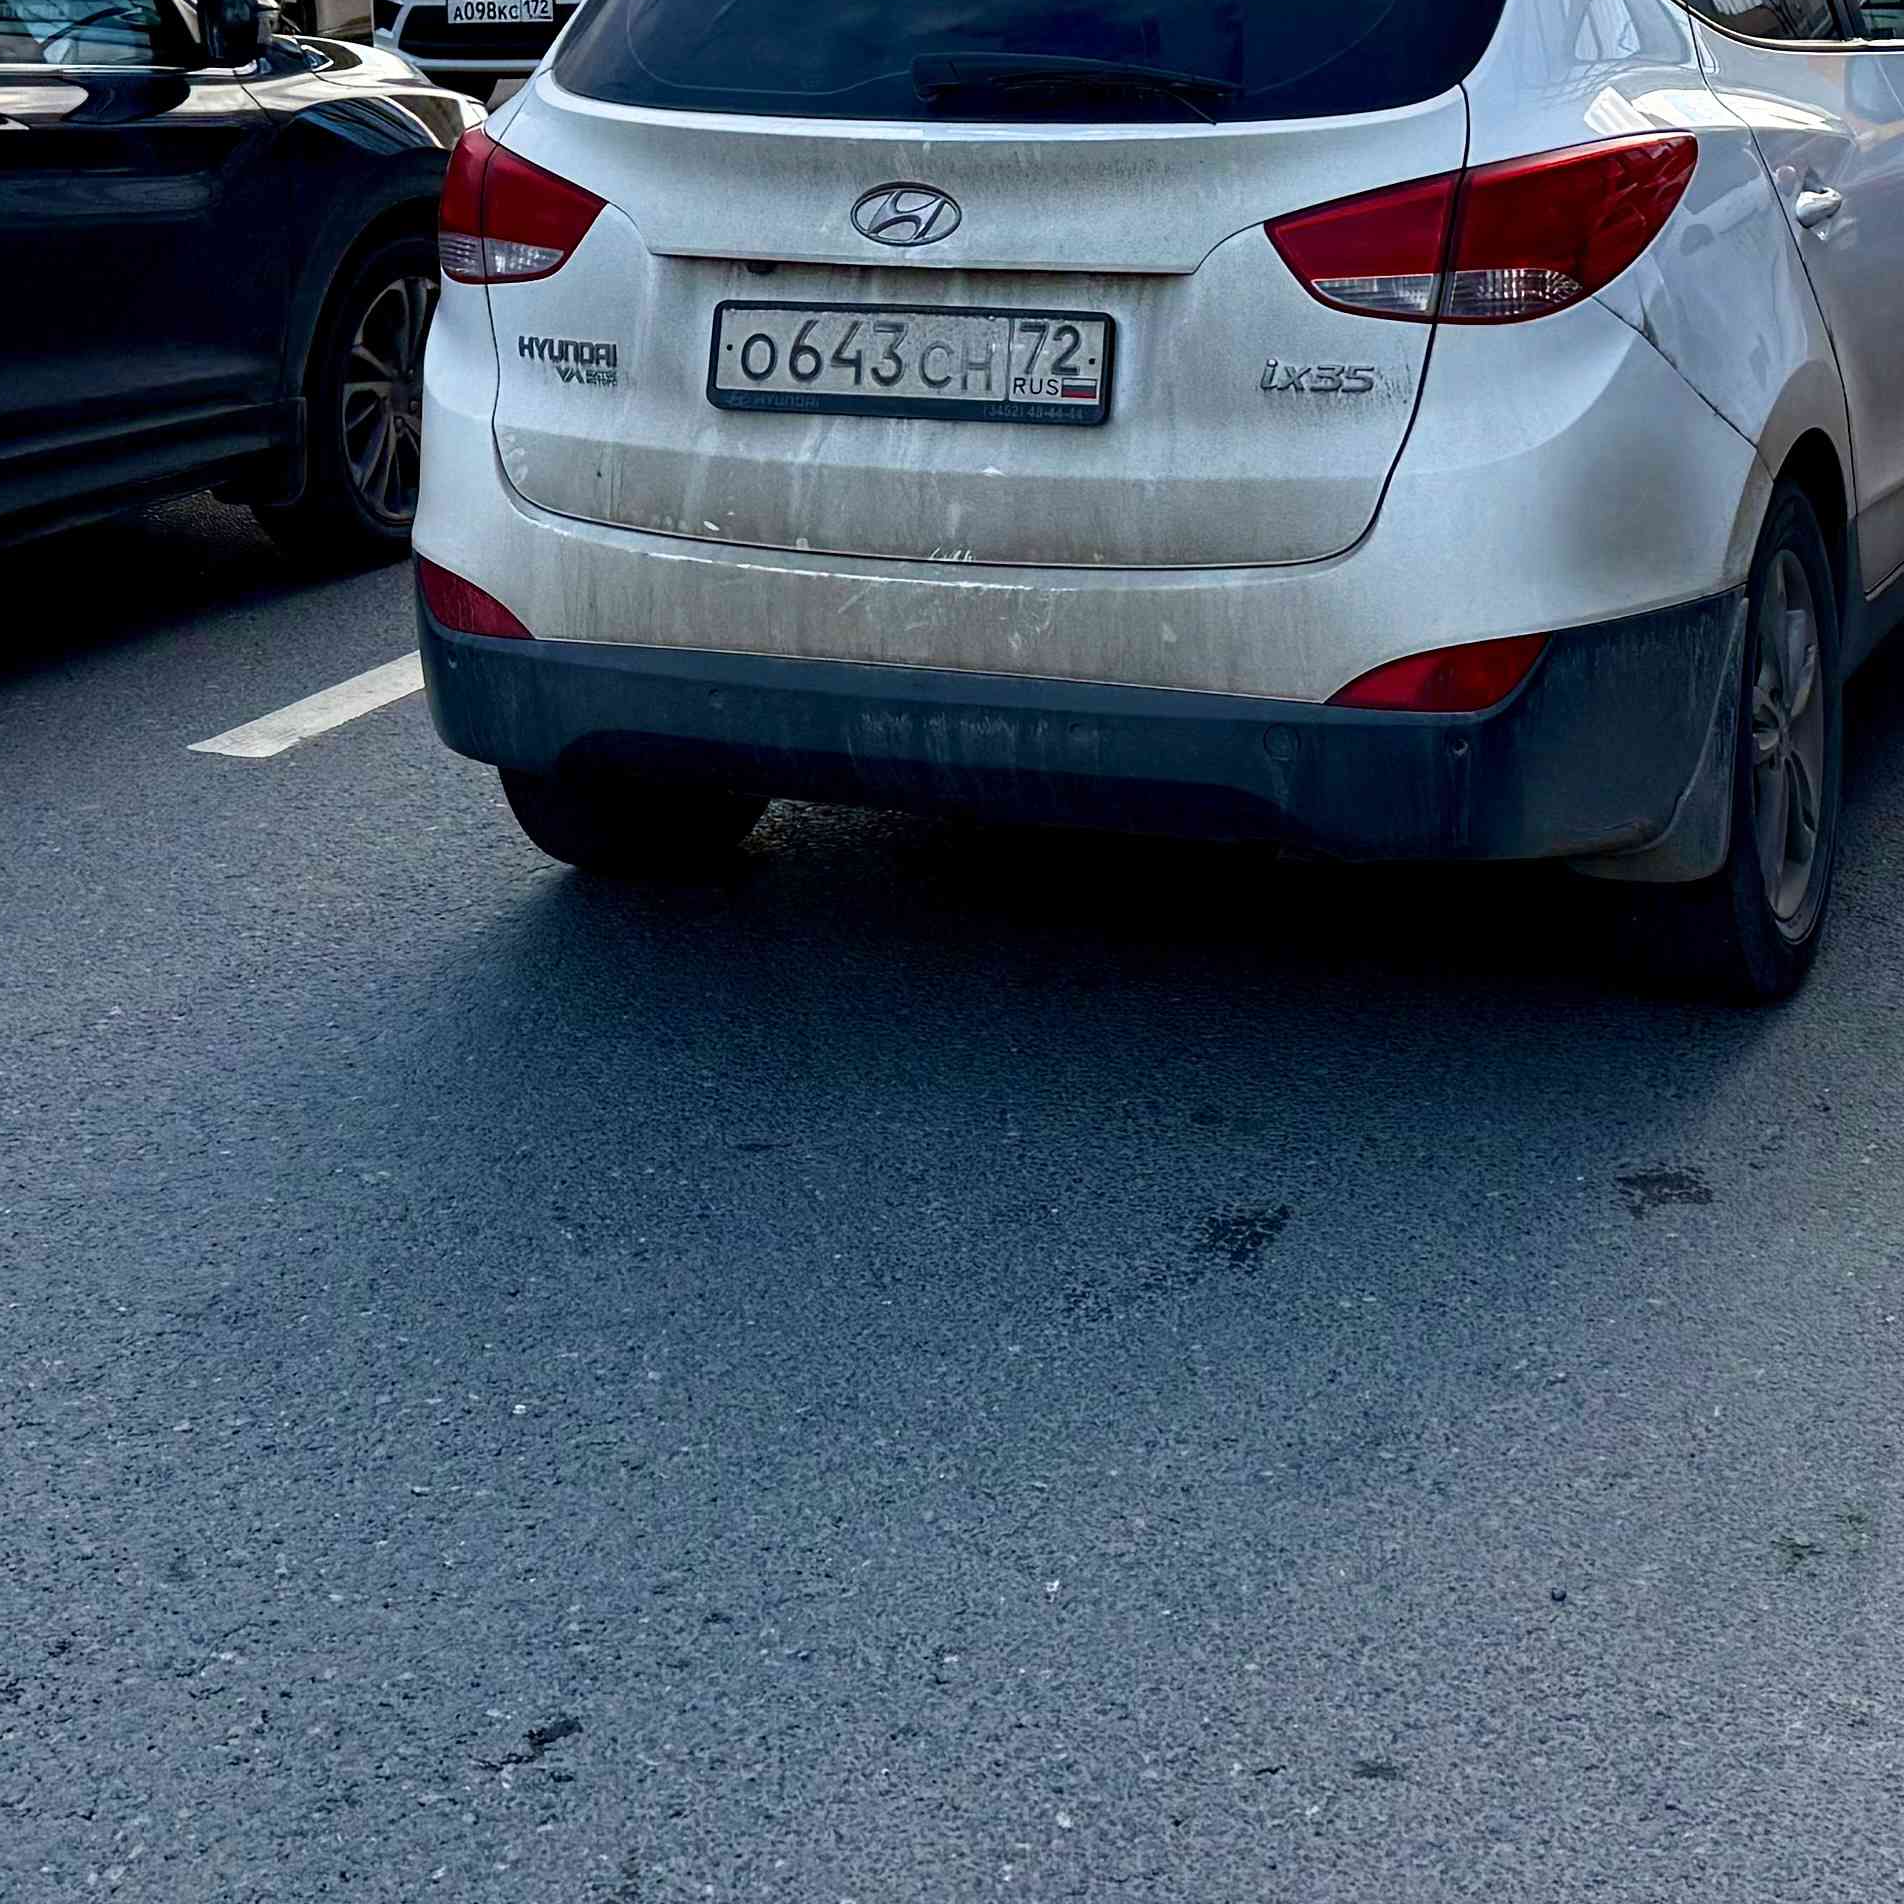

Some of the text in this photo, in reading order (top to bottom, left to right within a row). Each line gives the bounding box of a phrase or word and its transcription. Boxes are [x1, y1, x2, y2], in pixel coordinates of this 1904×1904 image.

[453, 0, 549, 21] А098КС 172
[518, 335, 617, 368] HYUNDAI
[740, 319, 1081, 394] О643СН 72
[1012, 378, 1060, 396] RUS
[1260, 358, 1375, 393] ix35
